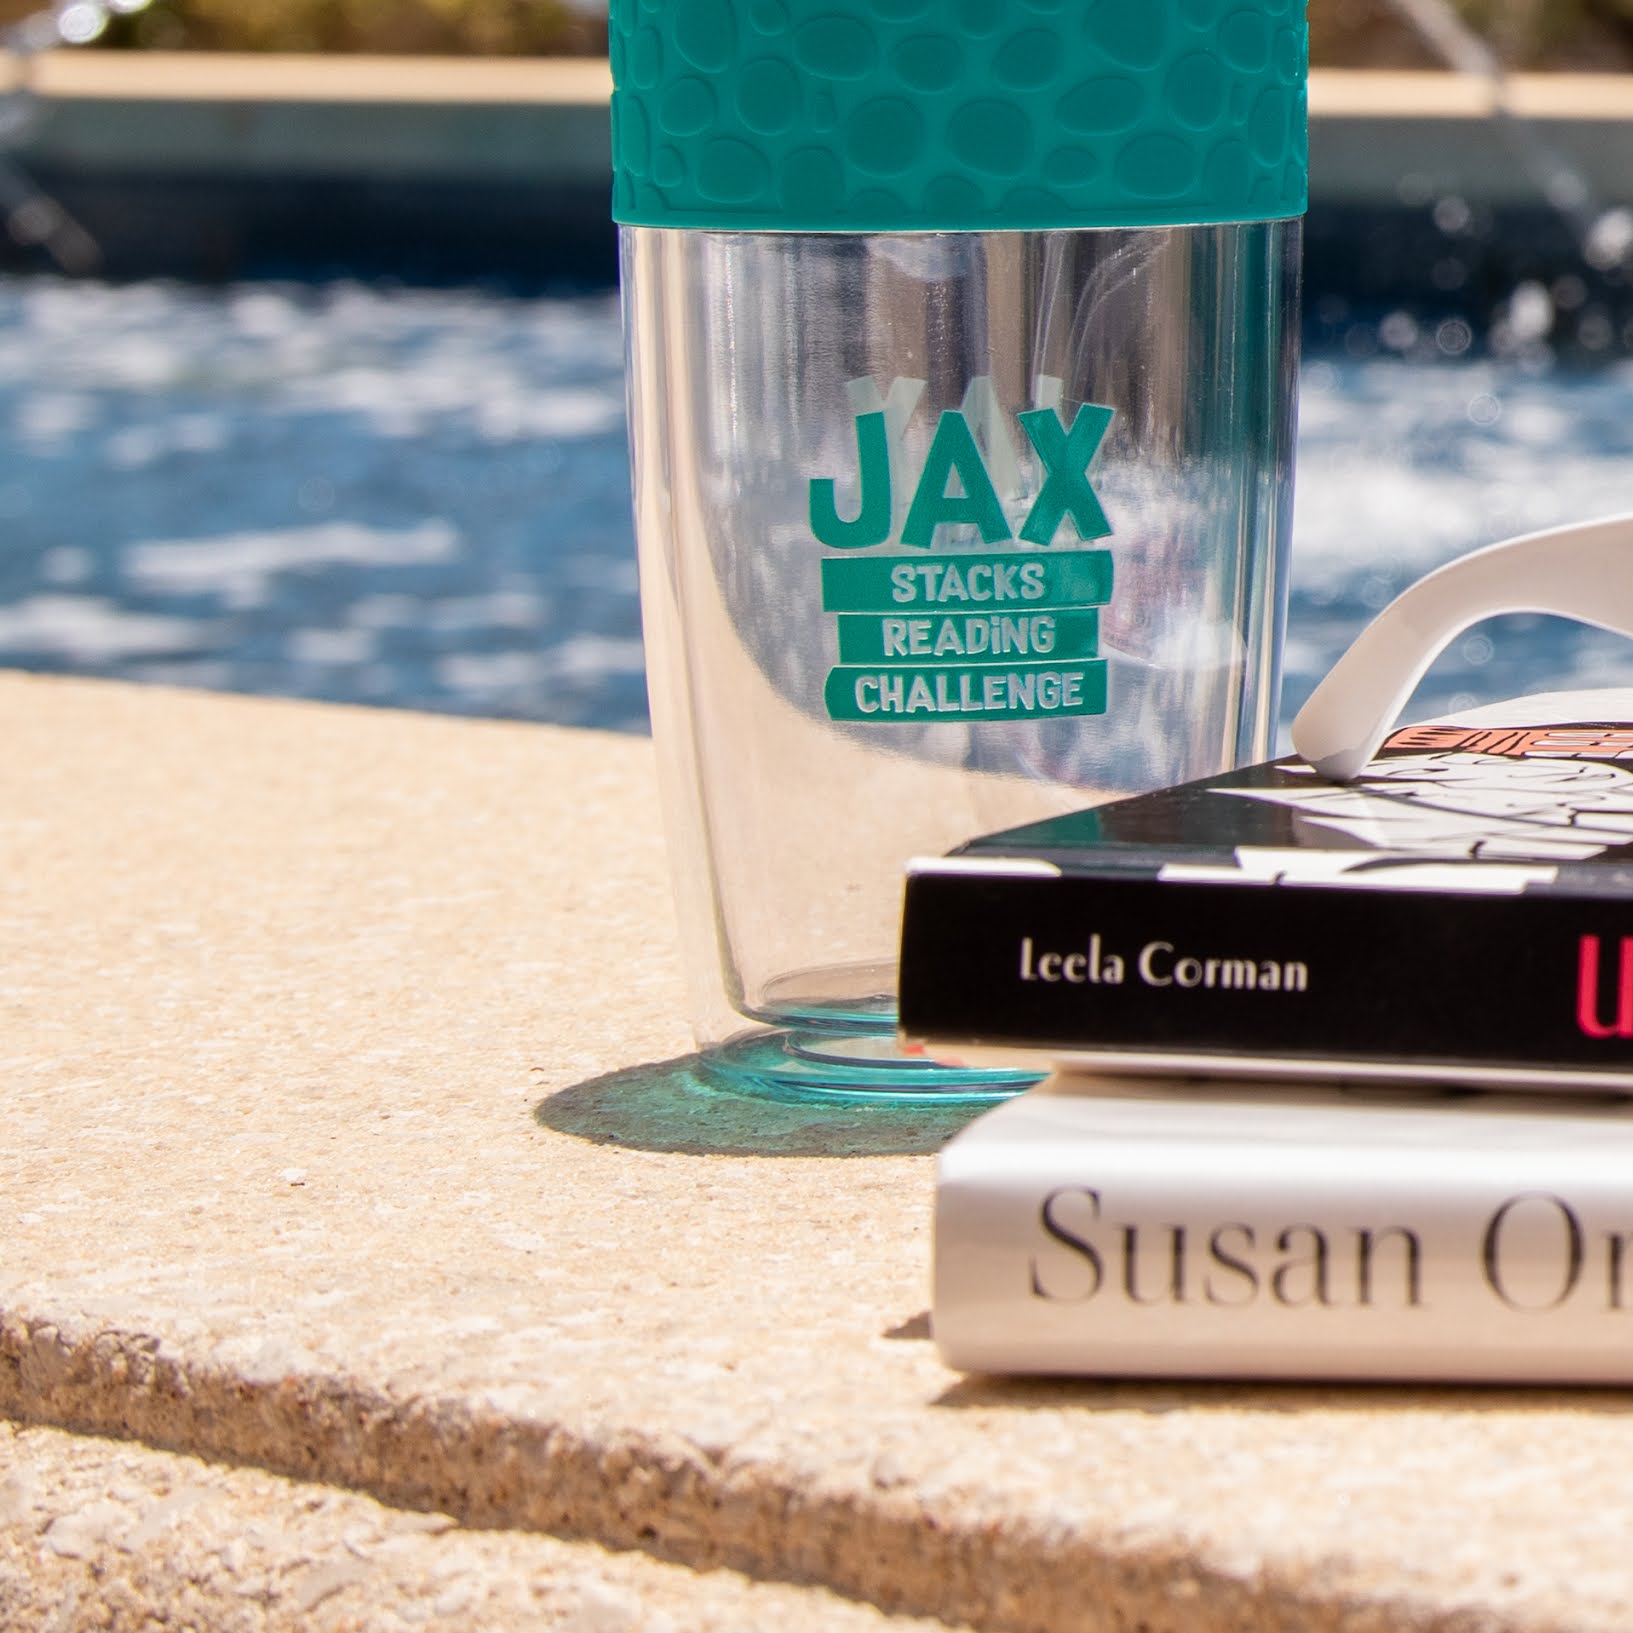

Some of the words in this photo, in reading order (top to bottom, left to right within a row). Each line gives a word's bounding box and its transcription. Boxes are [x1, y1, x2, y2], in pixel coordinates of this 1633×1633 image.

[808, 402, 1115, 550] JAX
[890, 562, 1045, 604] STACKS
[854, 671, 1085, 715] CHALLENGE
[1019, 933, 1125, 985] Leela
[1138, 939, 1309, 992] Corman
[1027, 1184, 1431, 1312] Susan
